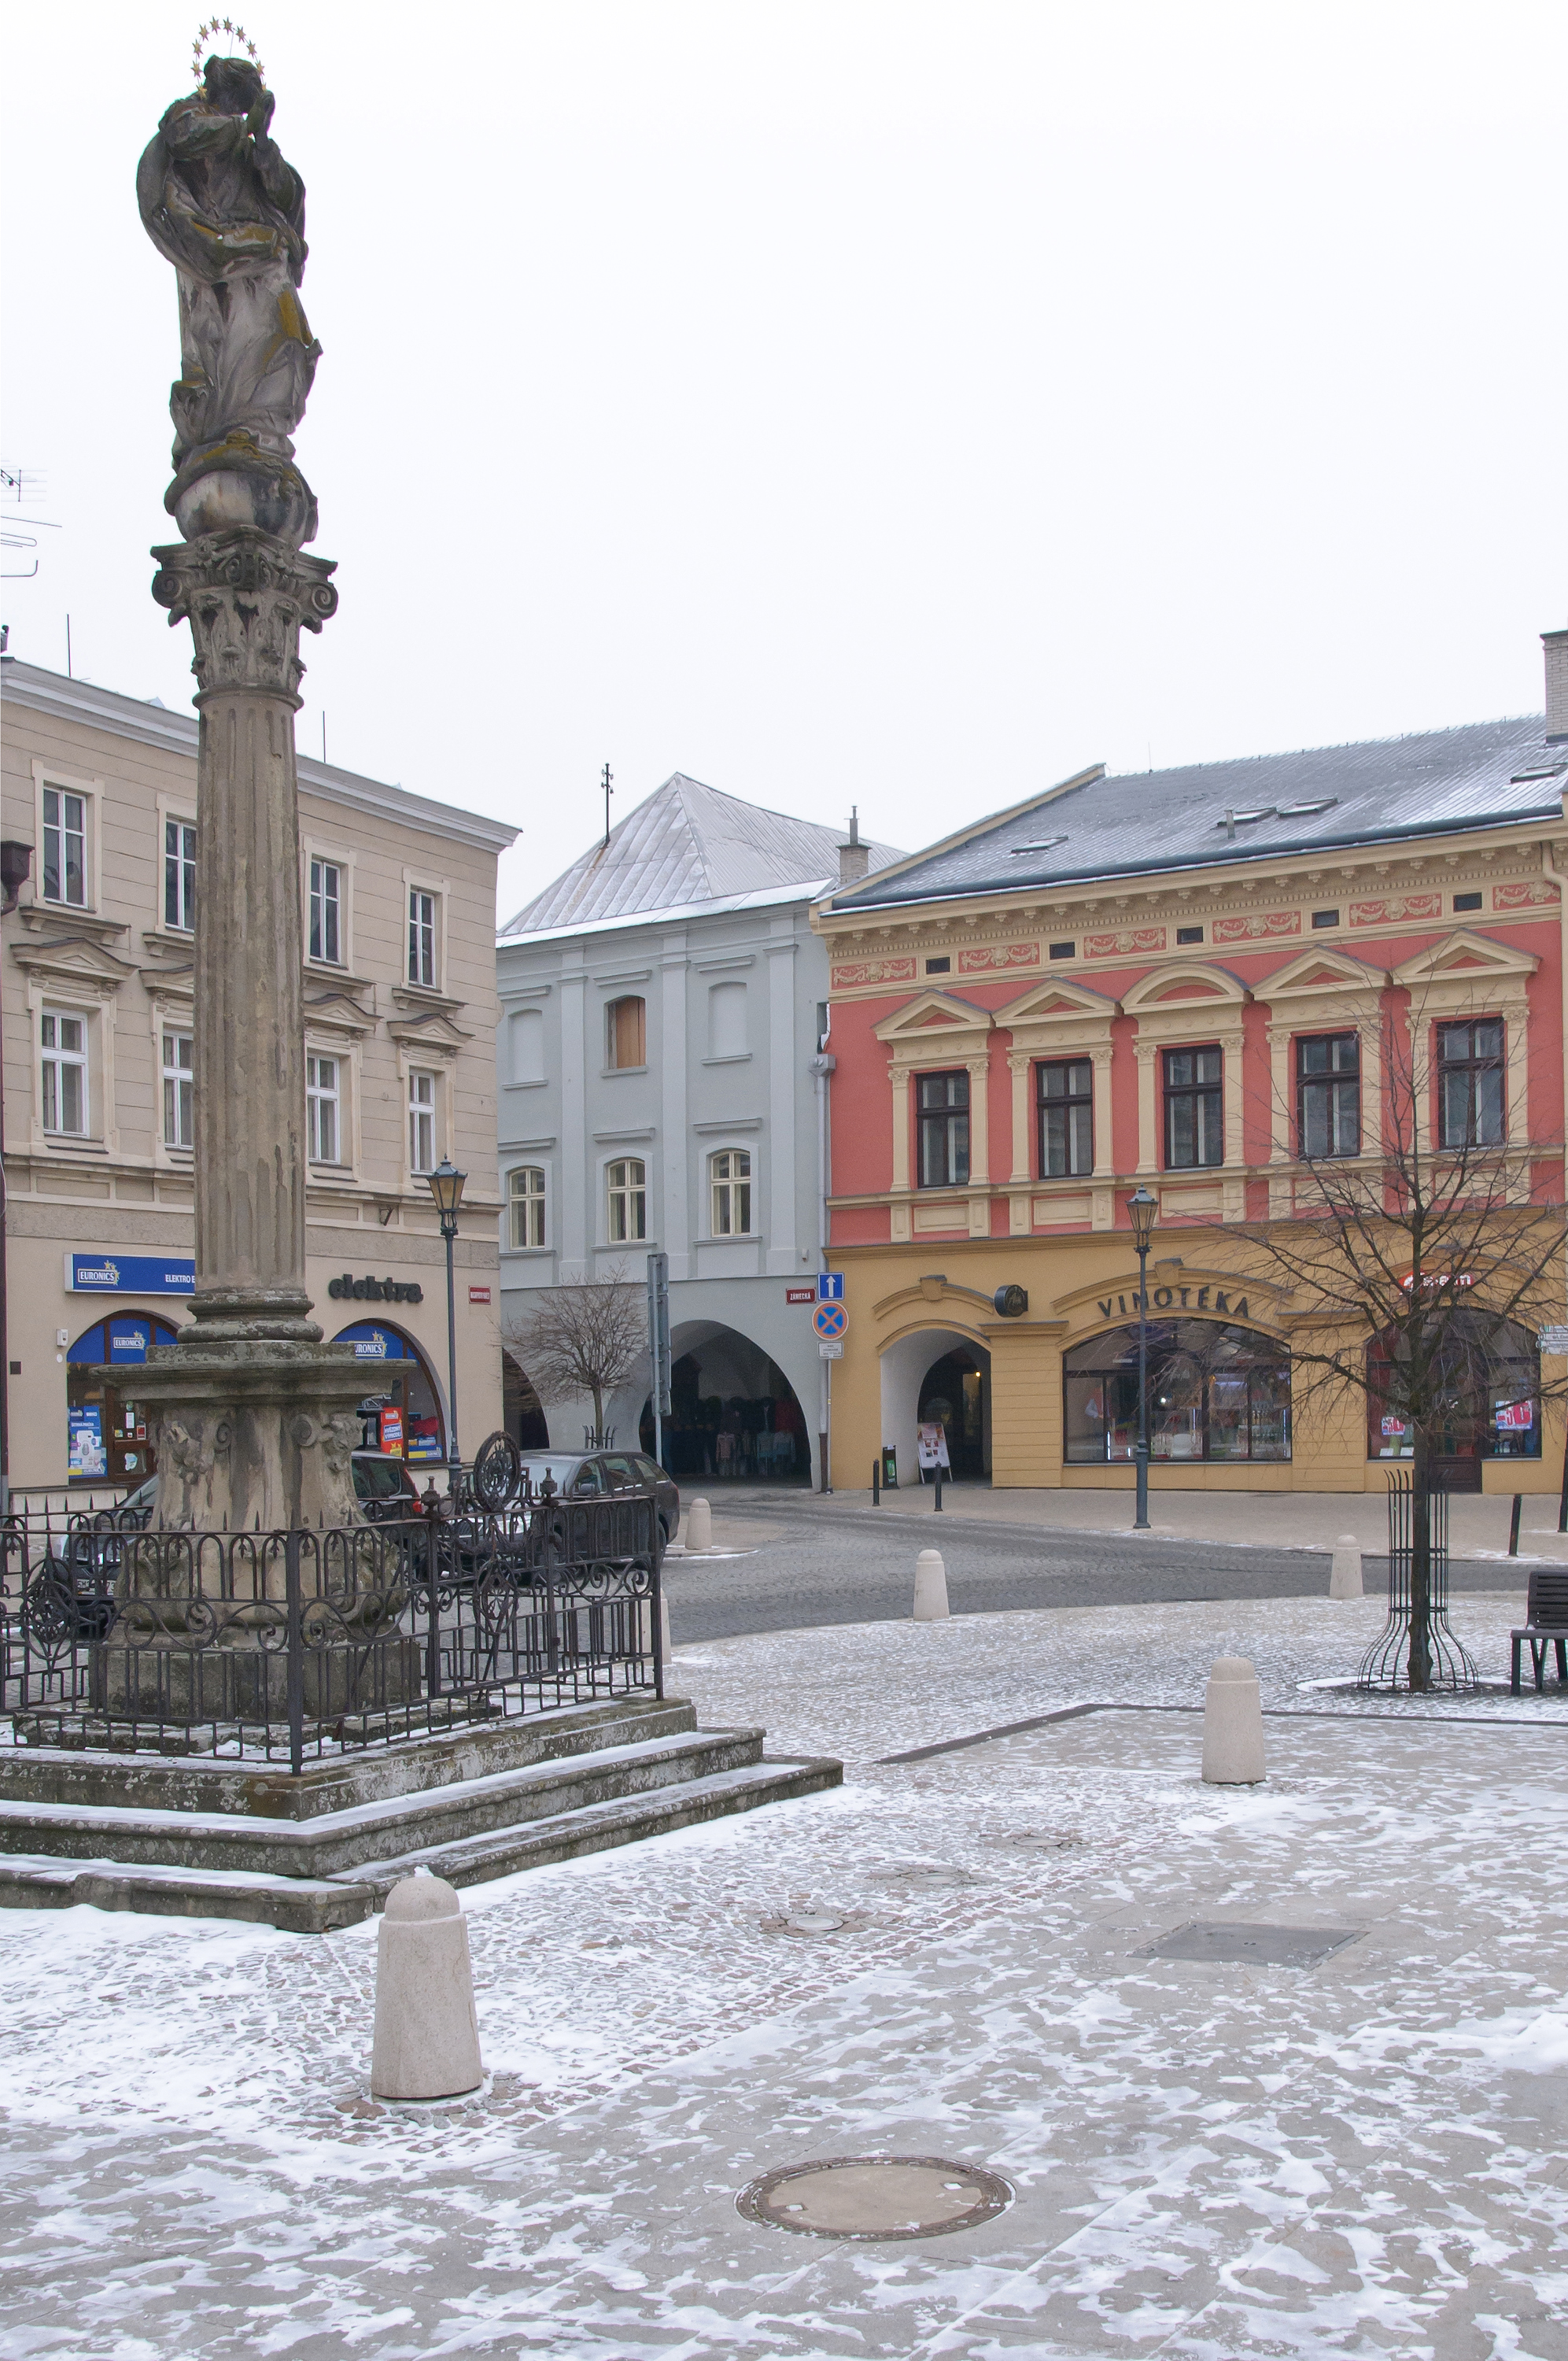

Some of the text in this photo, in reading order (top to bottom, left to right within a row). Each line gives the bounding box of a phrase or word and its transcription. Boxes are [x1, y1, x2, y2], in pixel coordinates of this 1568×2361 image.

[80, 1271, 115, 1281] EURONICS
[165, 1274, 190, 1284] ELEKTRO
[329, 1273, 423, 1303] elektra
[790, 1291, 811, 1301] ZÁMECKÁ
